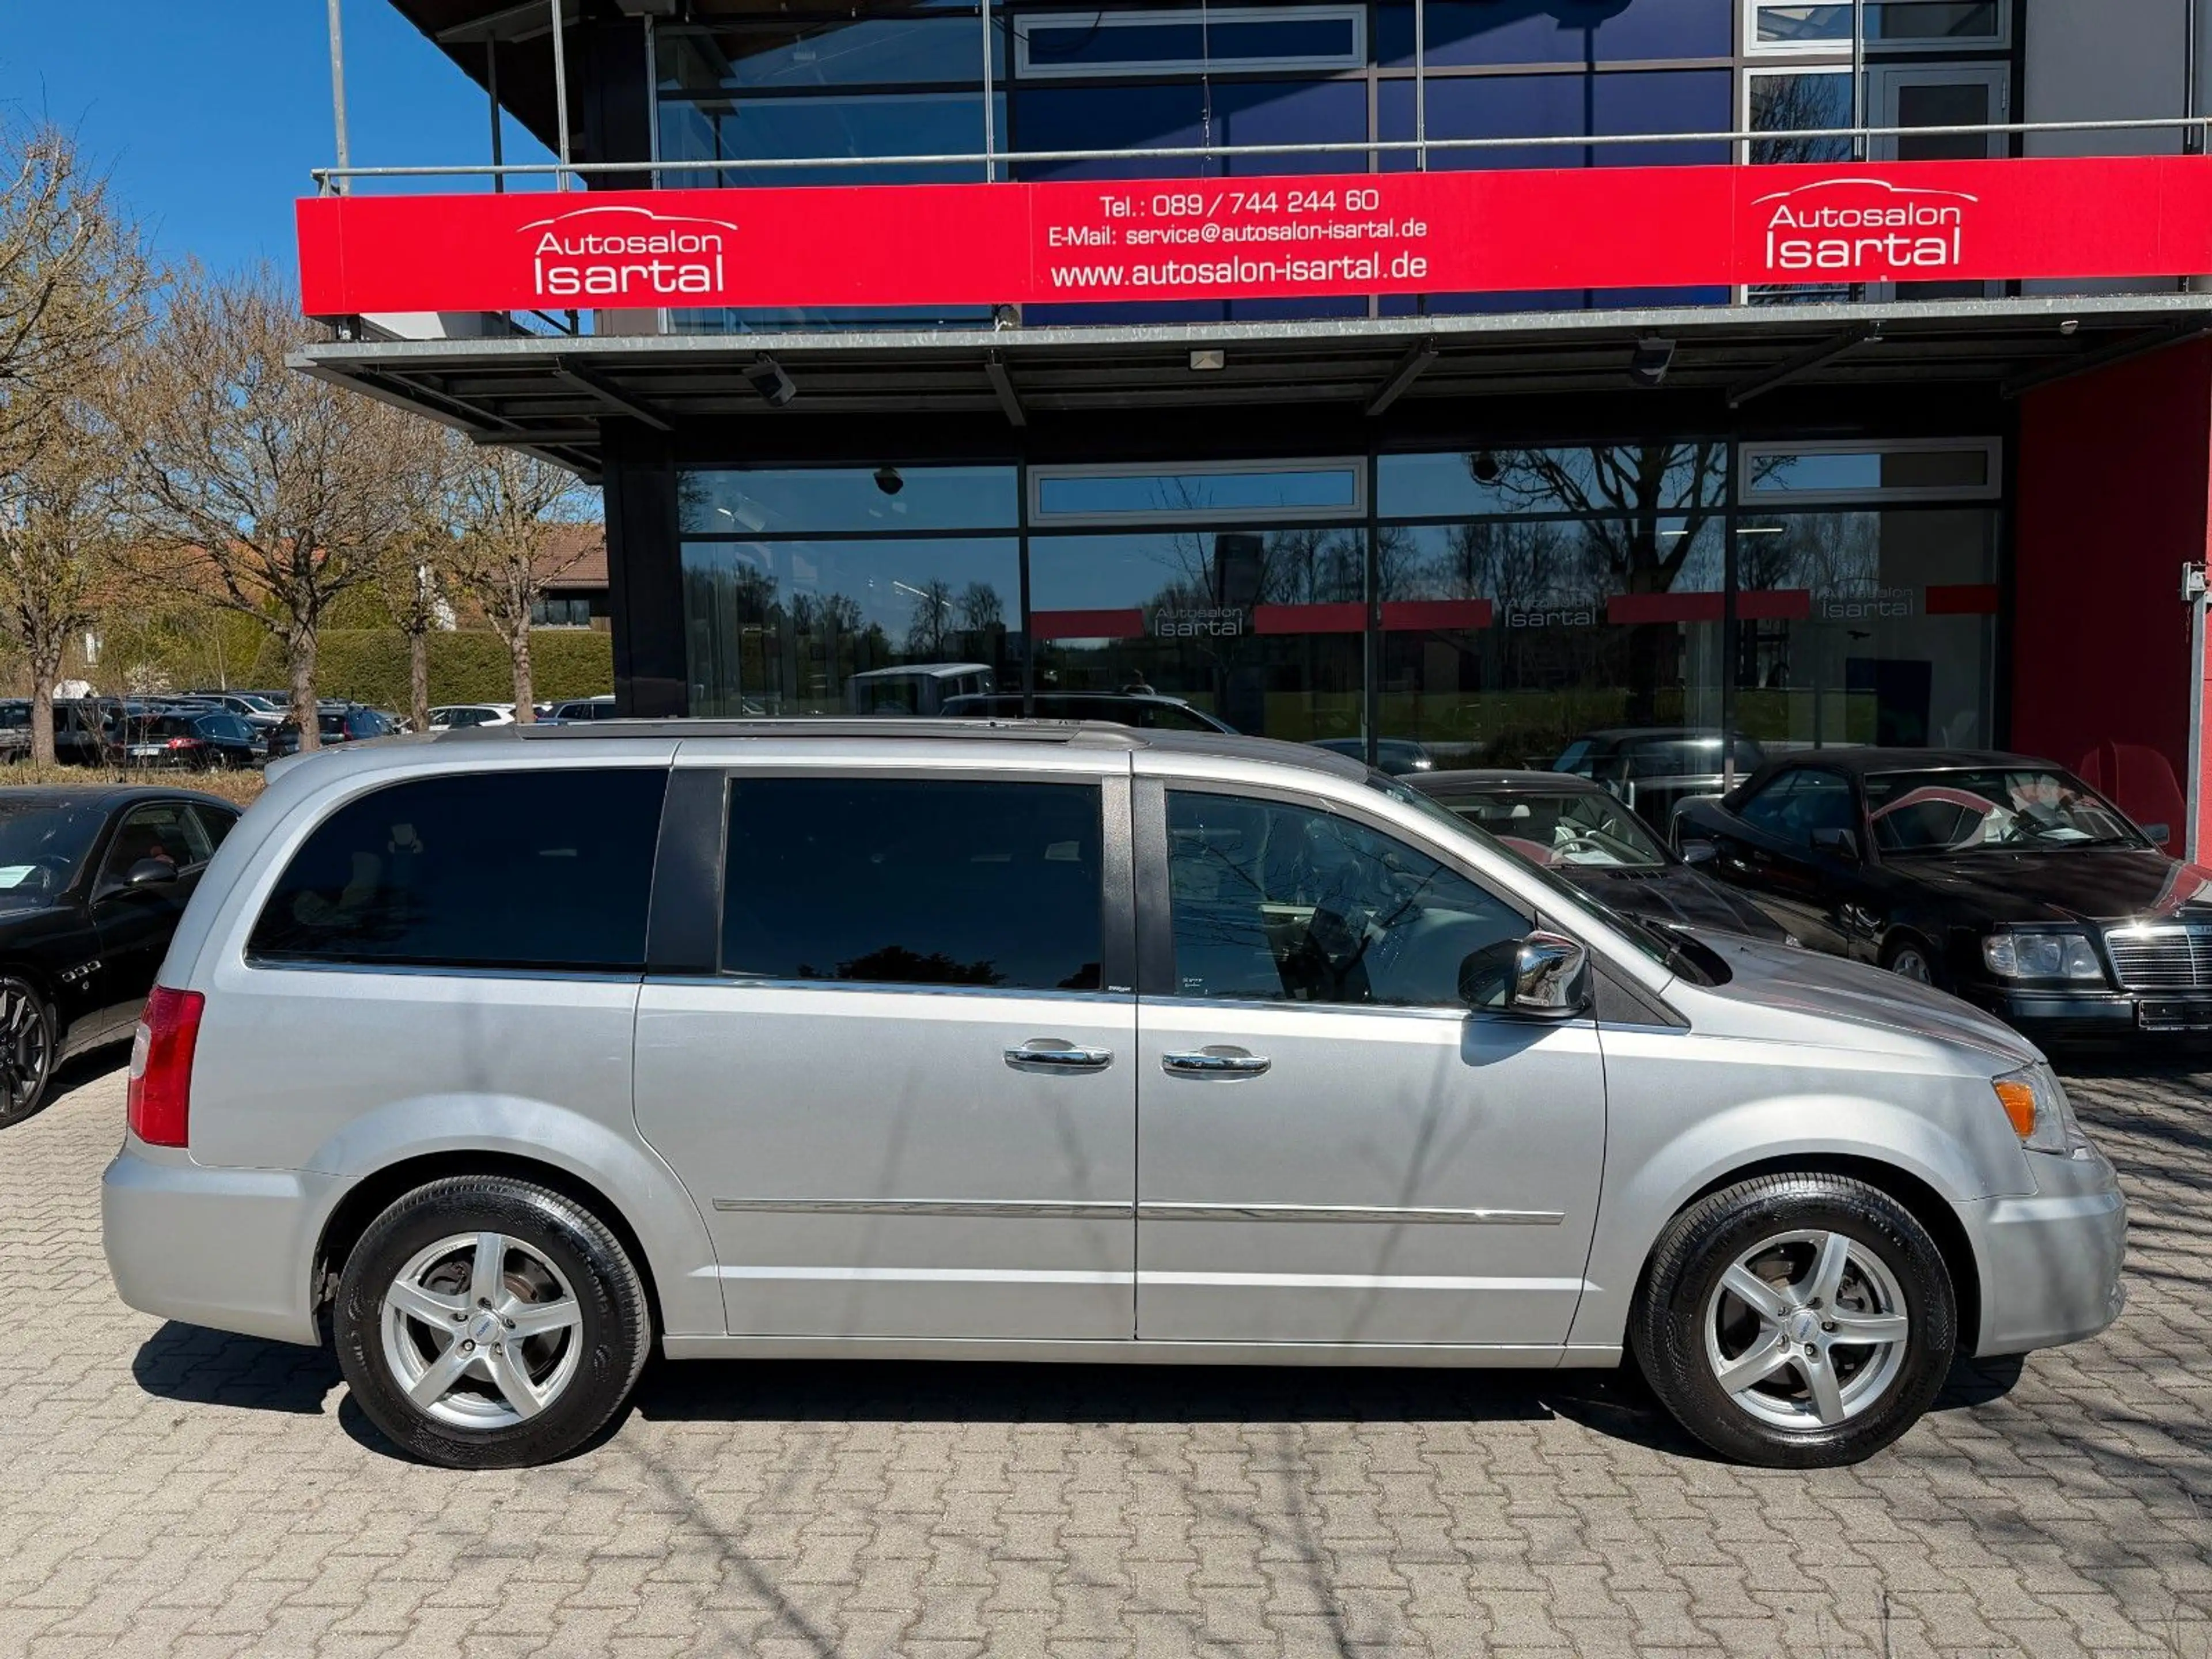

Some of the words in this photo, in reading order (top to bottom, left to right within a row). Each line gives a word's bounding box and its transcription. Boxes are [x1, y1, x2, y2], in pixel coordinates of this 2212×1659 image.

[1100, 195, 1145, 217] Tel.:
[1287, 190, 1336, 213] 244
[1346, 189, 1379, 211] 60
[1768, 202, 1960, 229] Autosalon
[535, 230, 722, 255] Autosalon
[1049, 225, 1116, 247] E-Mail:
[1126, 218, 1427, 245] service@autosalon-isartal.de
[1766, 226, 1960, 268] Isartal
[535, 254, 724, 294] Isartal
[1051, 251, 1427, 287] www.autosalon-isartal.de
[1156, 606, 1243, 619] Autosalon
[1505, 607, 1596, 627] Isartal
[1823, 599, 1912, 619] Isartal
[1155, 617, 1243, 637] Isartal
